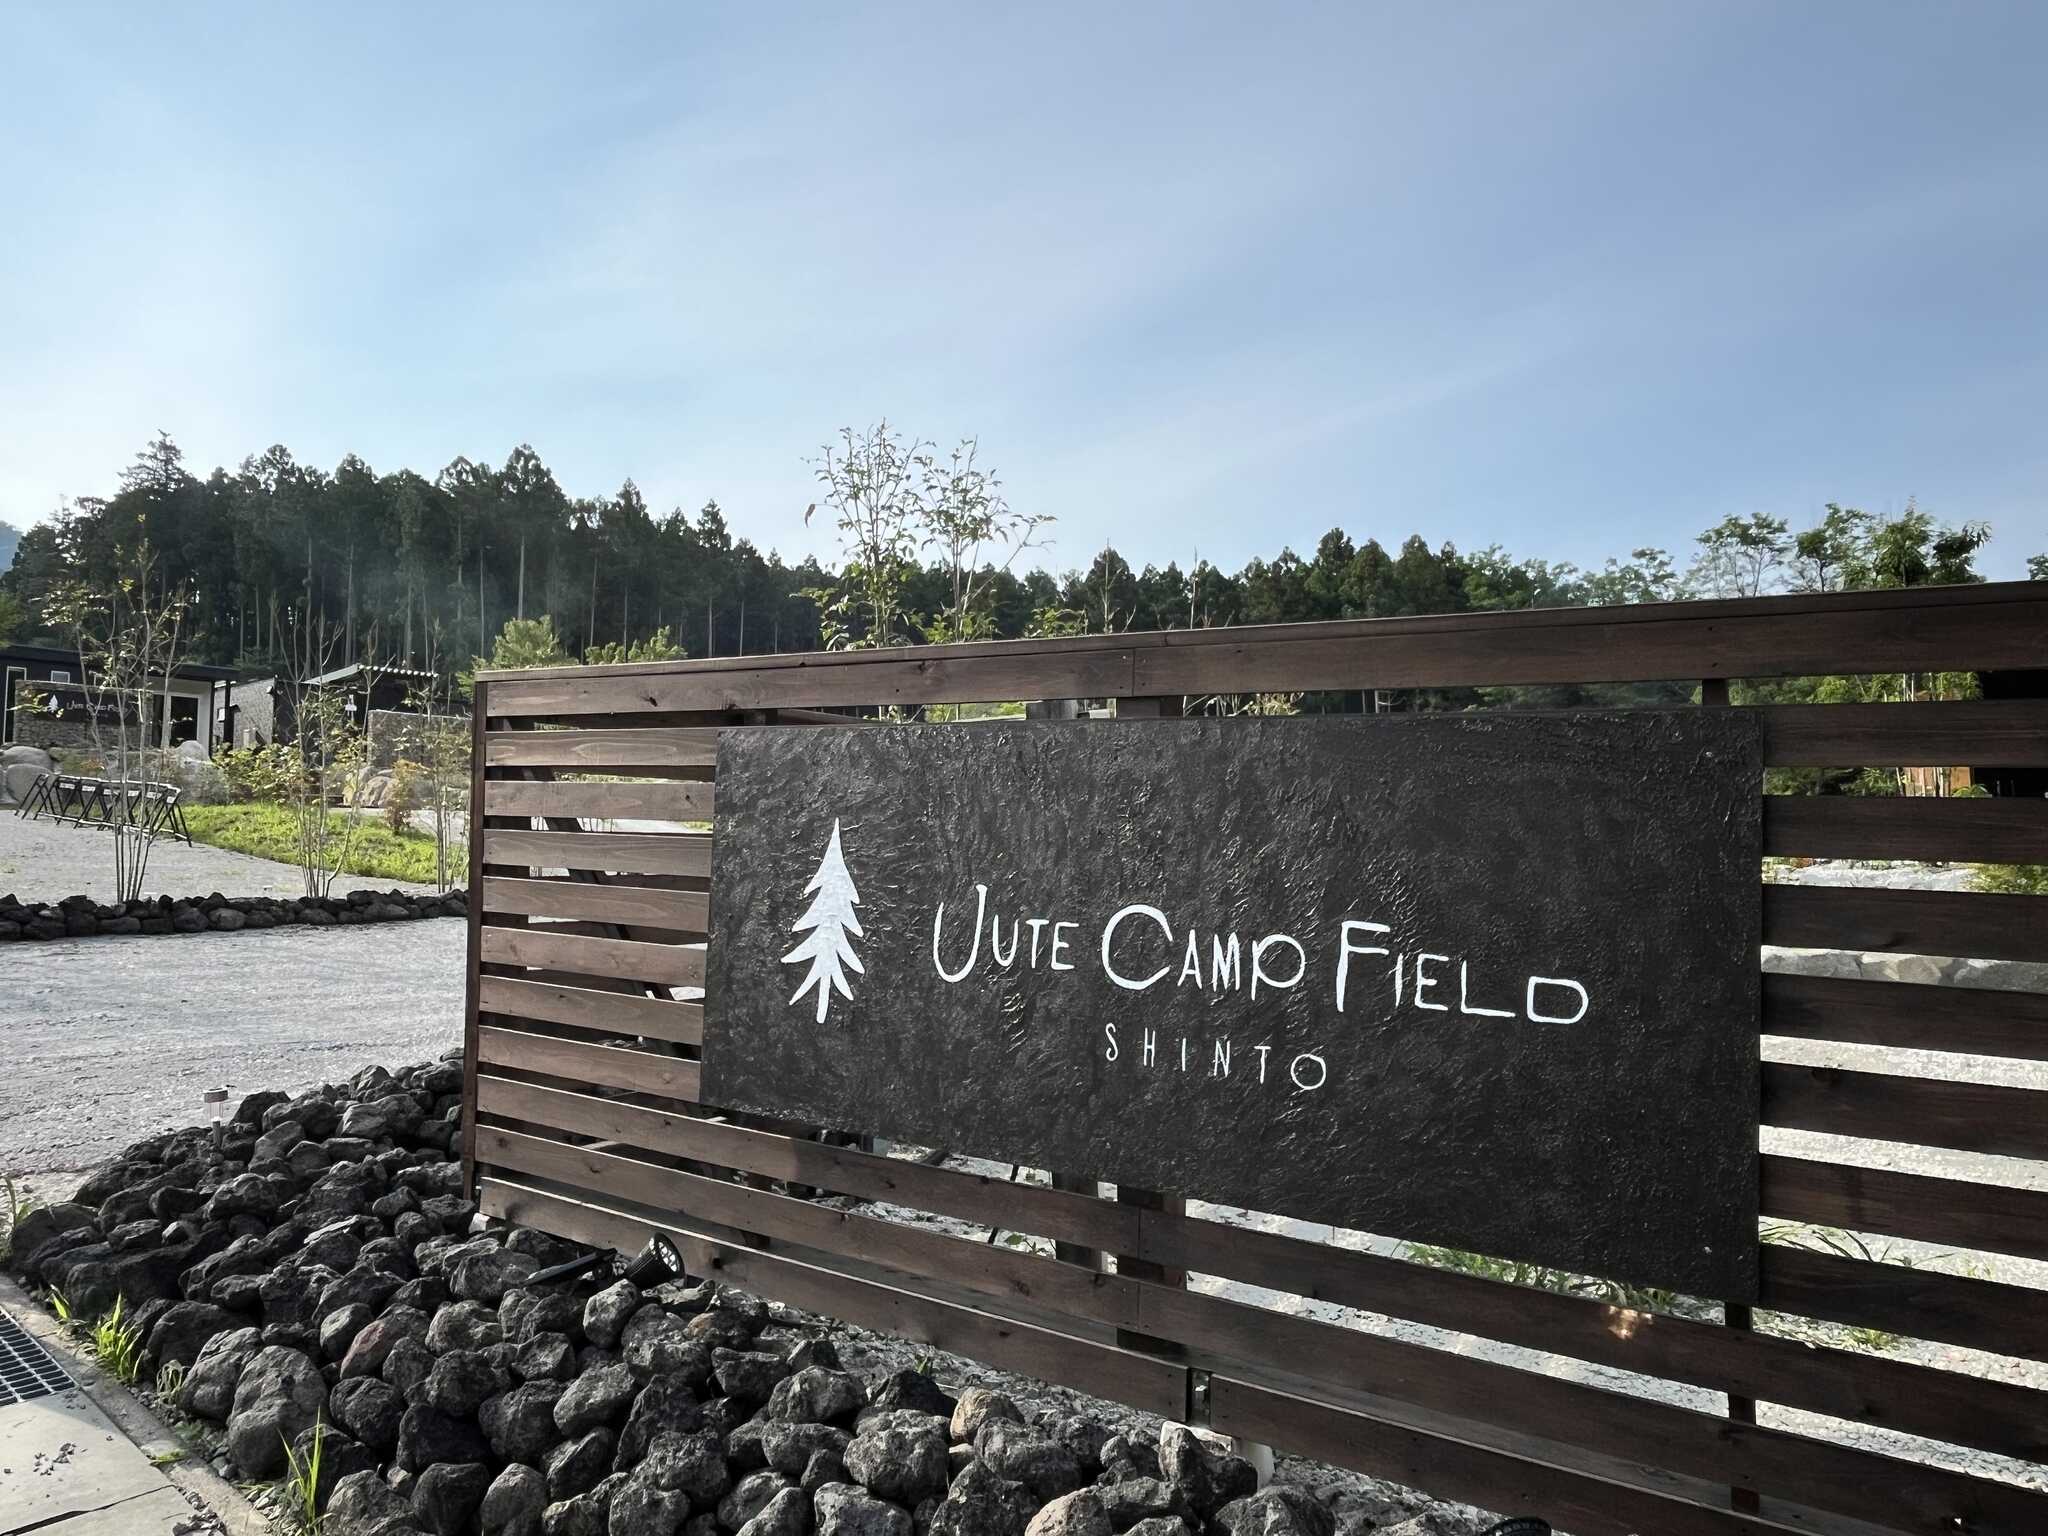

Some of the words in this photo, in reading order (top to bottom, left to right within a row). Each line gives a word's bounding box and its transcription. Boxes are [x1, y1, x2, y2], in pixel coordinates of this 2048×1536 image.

[931, 882, 1080, 985] UUTE
[1099, 903, 1309, 1002] CAMP
[1334, 919, 1590, 1026] FIELD
[1104, 1021, 1328, 1094] SHINTO
